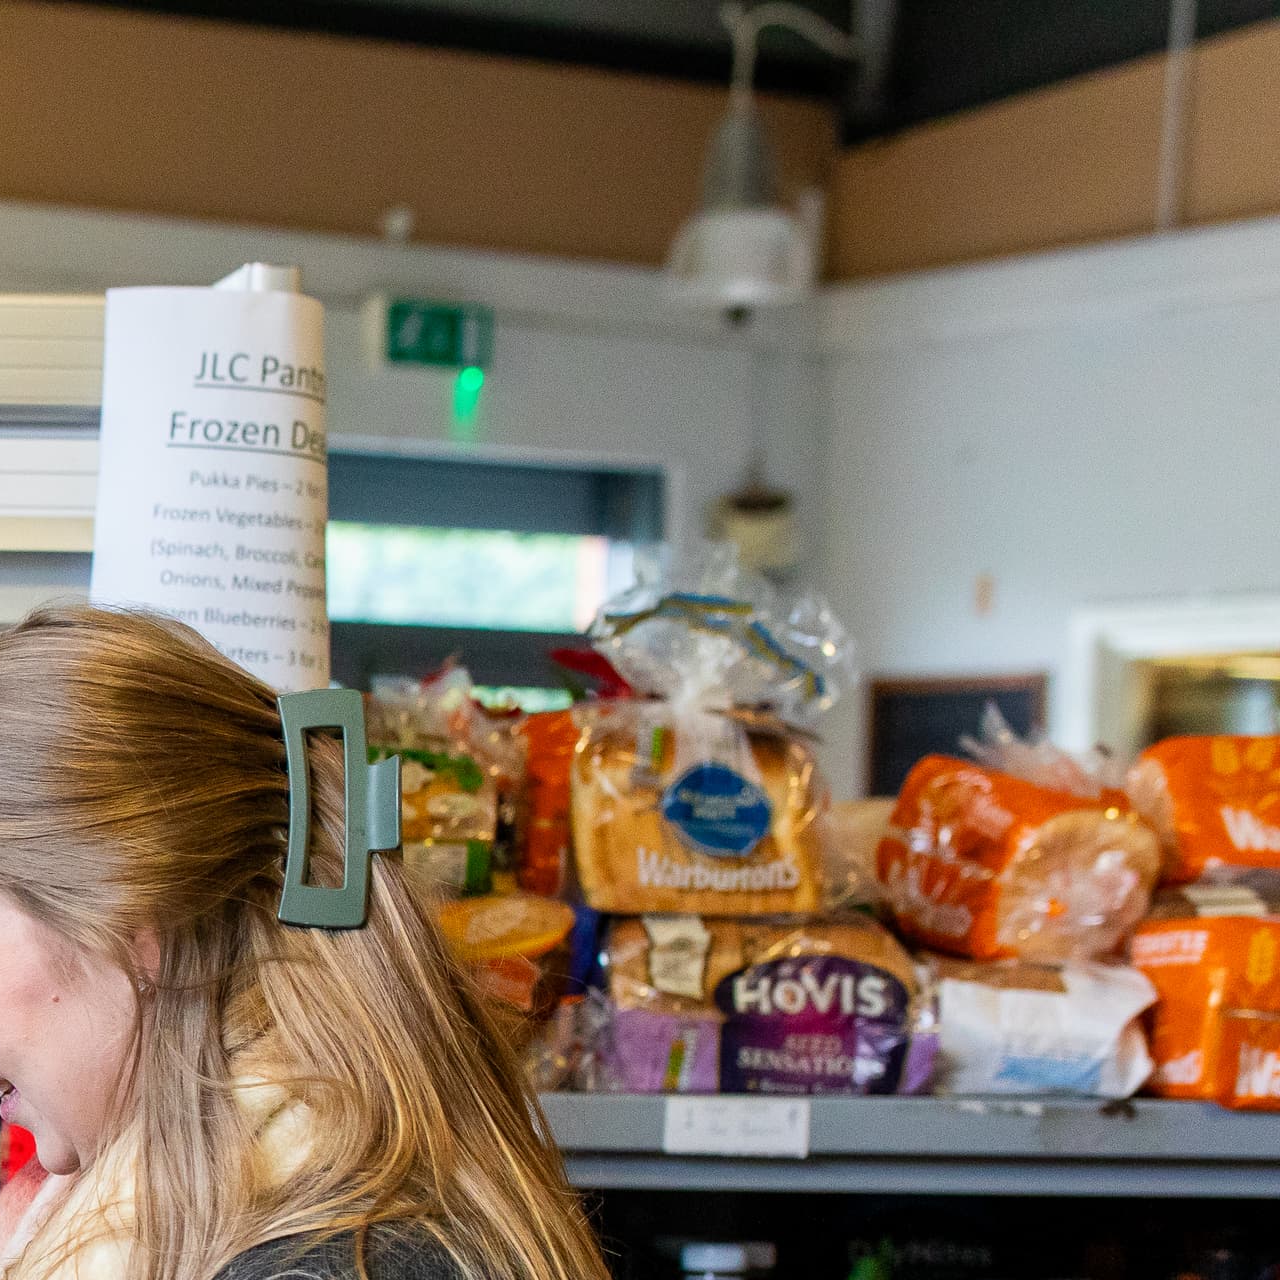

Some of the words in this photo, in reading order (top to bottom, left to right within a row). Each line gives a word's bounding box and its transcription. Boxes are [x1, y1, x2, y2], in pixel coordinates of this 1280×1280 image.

[194, 351, 249, 382] JLC
[169, 411, 281, 447] Frozen
[190, 470, 240, 490] Pukka
[246, 474, 279, 493] Pies
[153, 503, 211, 522] Frozen
[216, 507, 304, 531] Vegetables
[160, 568, 226, 591] Onions,
[232, 575, 282, 595] Mixed
[204, 607, 297, 632] Blueberries
